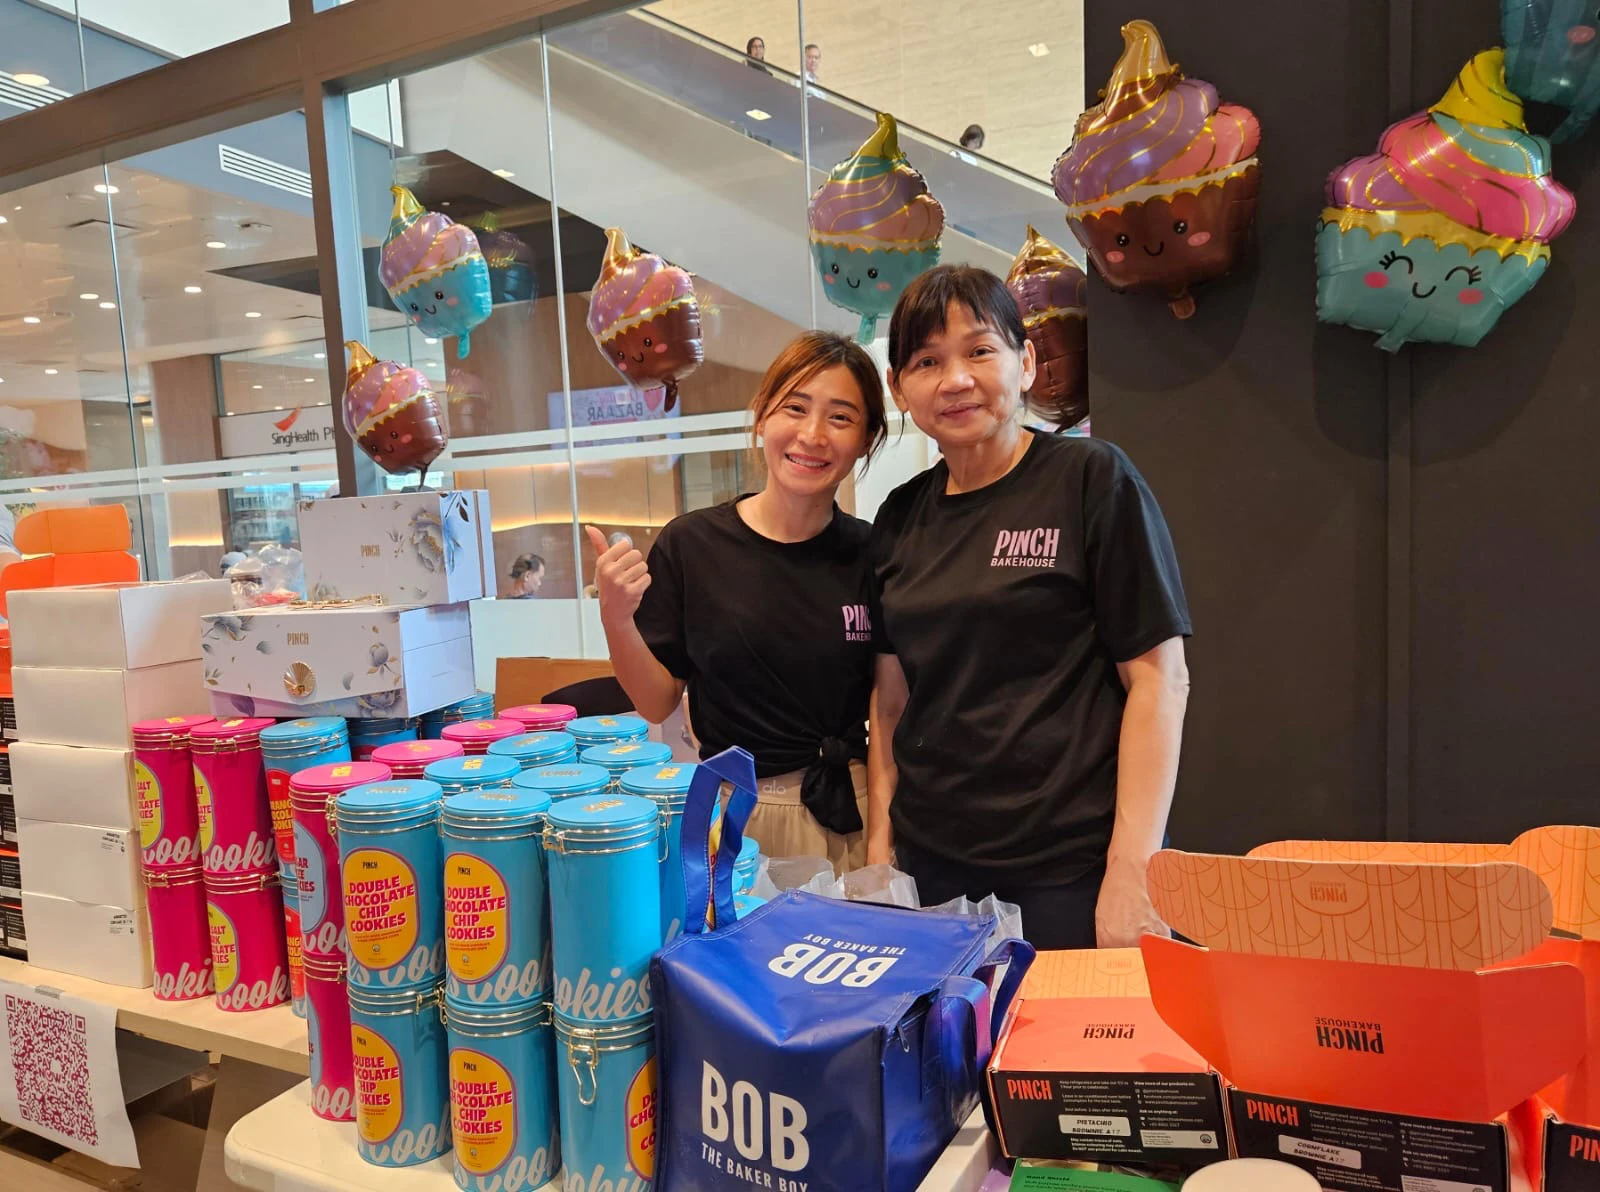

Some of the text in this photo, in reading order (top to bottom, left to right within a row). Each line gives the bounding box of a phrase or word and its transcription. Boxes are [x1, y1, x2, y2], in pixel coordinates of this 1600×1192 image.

[271, 428, 319, 447] SingHealth
[361, 544, 380, 557] PINCH
[993, 527, 1060, 558] PINCH
[990, 557, 1056, 568] BAKEHOUSE
[287, 632, 309, 645] PINCH
[762, 779, 786, 794] alo
[349, 875, 401, 894] DOUBLE
[447, 885, 492, 899] DOUBLE
[345, 884, 415, 907] CHOCOLATE
[1310, 886, 1348, 903] PINCH
[358, 903, 390, 919] CHIP
[445, 896, 506, 913] HOCOLATE
[350, 912, 406, 932] COOKIES
[452, 913, 480, 928] CHIP
[447, 925, 496, 940] COOKIES
[803, 933, 907, 956] THE BAKER BOY
[767, 943, 899, 988] BOB
[553, 967, 652, 1020] okies
[1314, 1016, 1381, 1031] BAKEHOUSE
[1083, 1027, 1135, 1039] PINCH
[1315, 1026, 1385, 1055] PINCH
[353, 1055, 385, 1068] OUBLE
[452, 1080, 498, 1095] DOUBLE
[1006, 1079, 1053, 1100] PINCH
[459, 1108, 487, 1121] CHIP
[701, 1059, 811, 1172] BOB
[1246, 1099, 1299, 1127] PINCH
[453, 1120, 503, 1135] COOKIES
[1076, 1119, 1113, 1127] PISTACHIO
[1569, 1134, 1600, 1163] PIN
[701, 1141, 809, 1192] THE BAKER BOY
